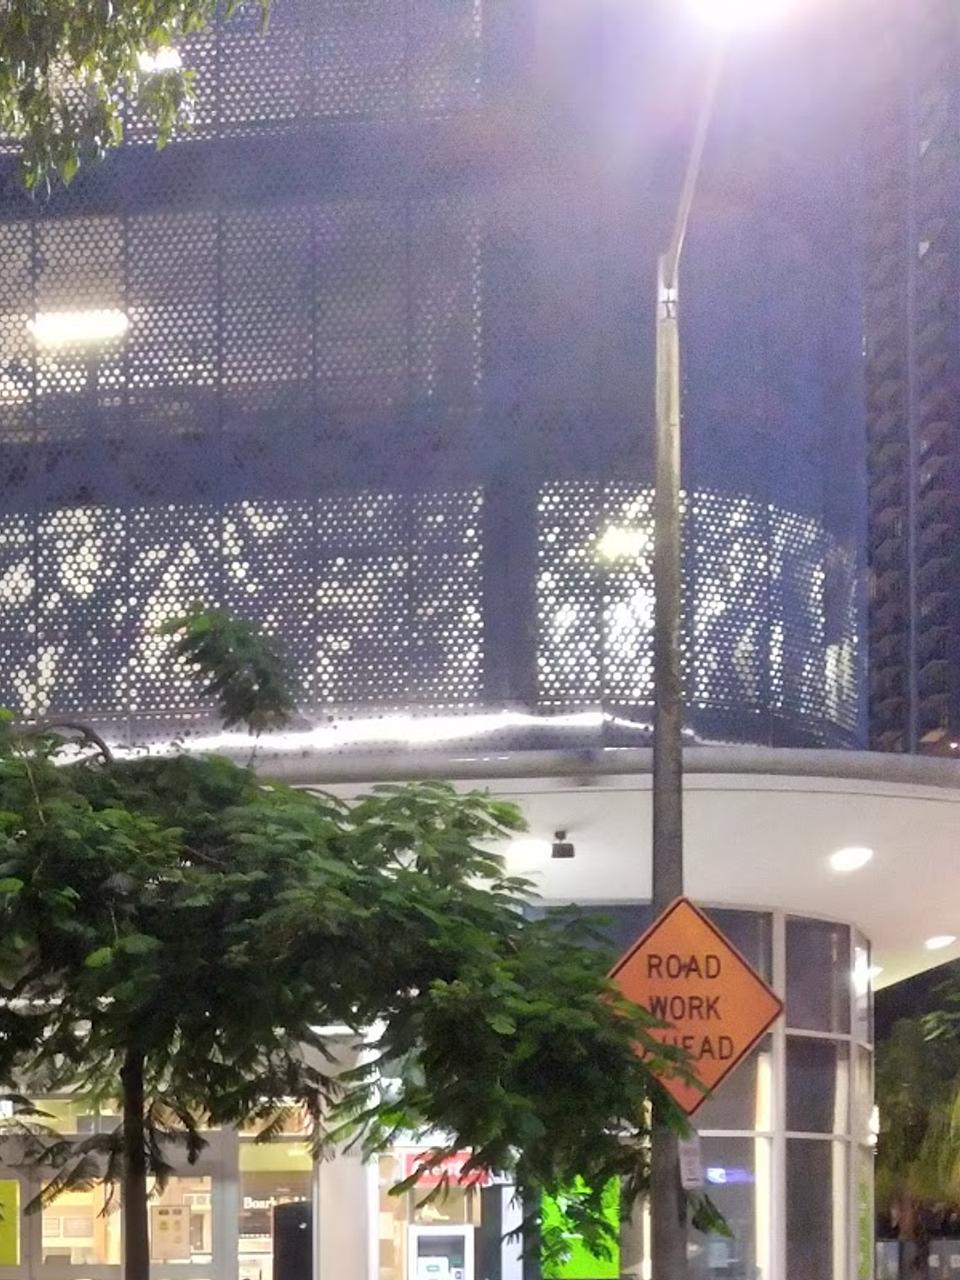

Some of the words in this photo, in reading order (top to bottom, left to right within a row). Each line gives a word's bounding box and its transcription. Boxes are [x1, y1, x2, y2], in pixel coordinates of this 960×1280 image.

[647, 954, 721, 979] ROAD
[648, 995, 722, 1020] WORK
[642, 1034, 734, 1060] EAD
